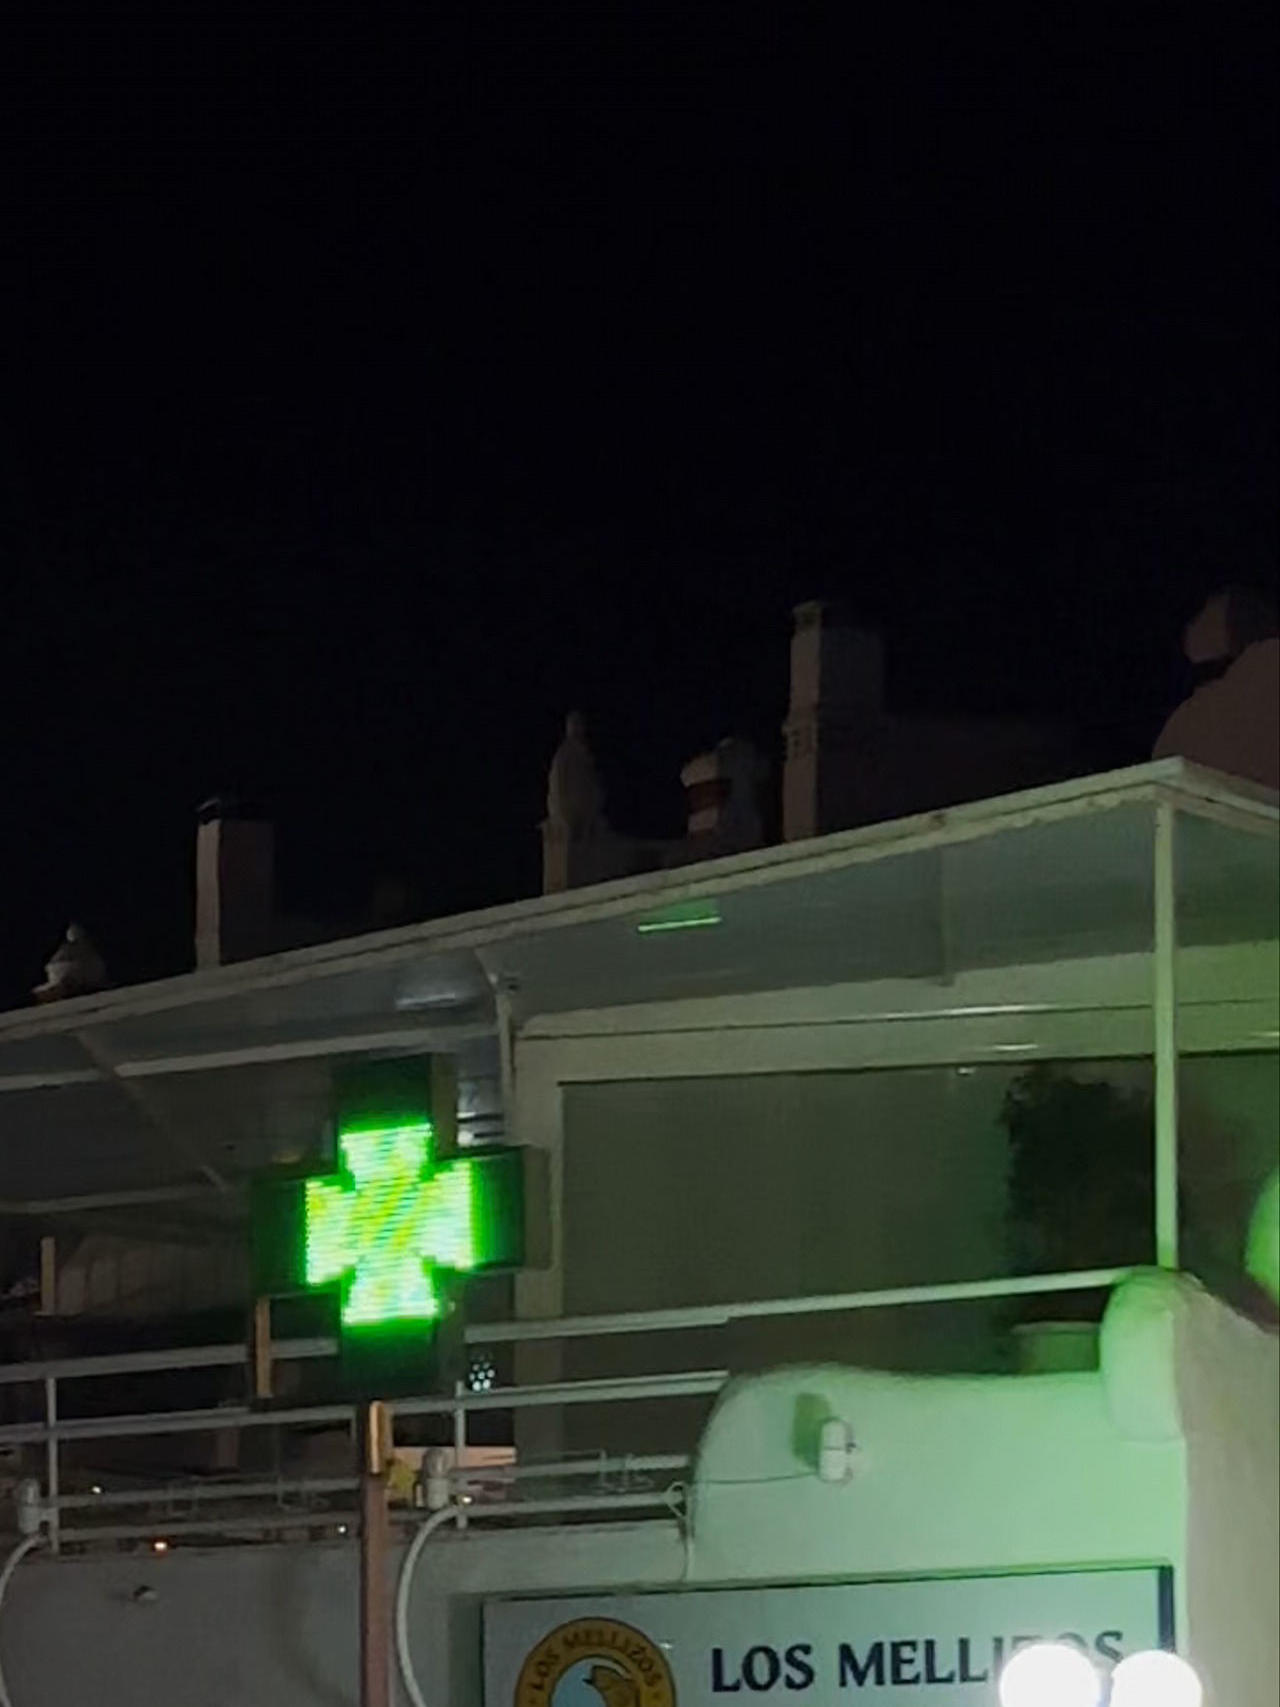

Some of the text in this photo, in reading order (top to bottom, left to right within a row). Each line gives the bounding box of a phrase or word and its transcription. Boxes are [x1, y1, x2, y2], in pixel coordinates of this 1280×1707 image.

[530, 1629, 664, 1691] LOS MELLIZOS
[711, 1631, 1125, 1693] LOS MELLIS
